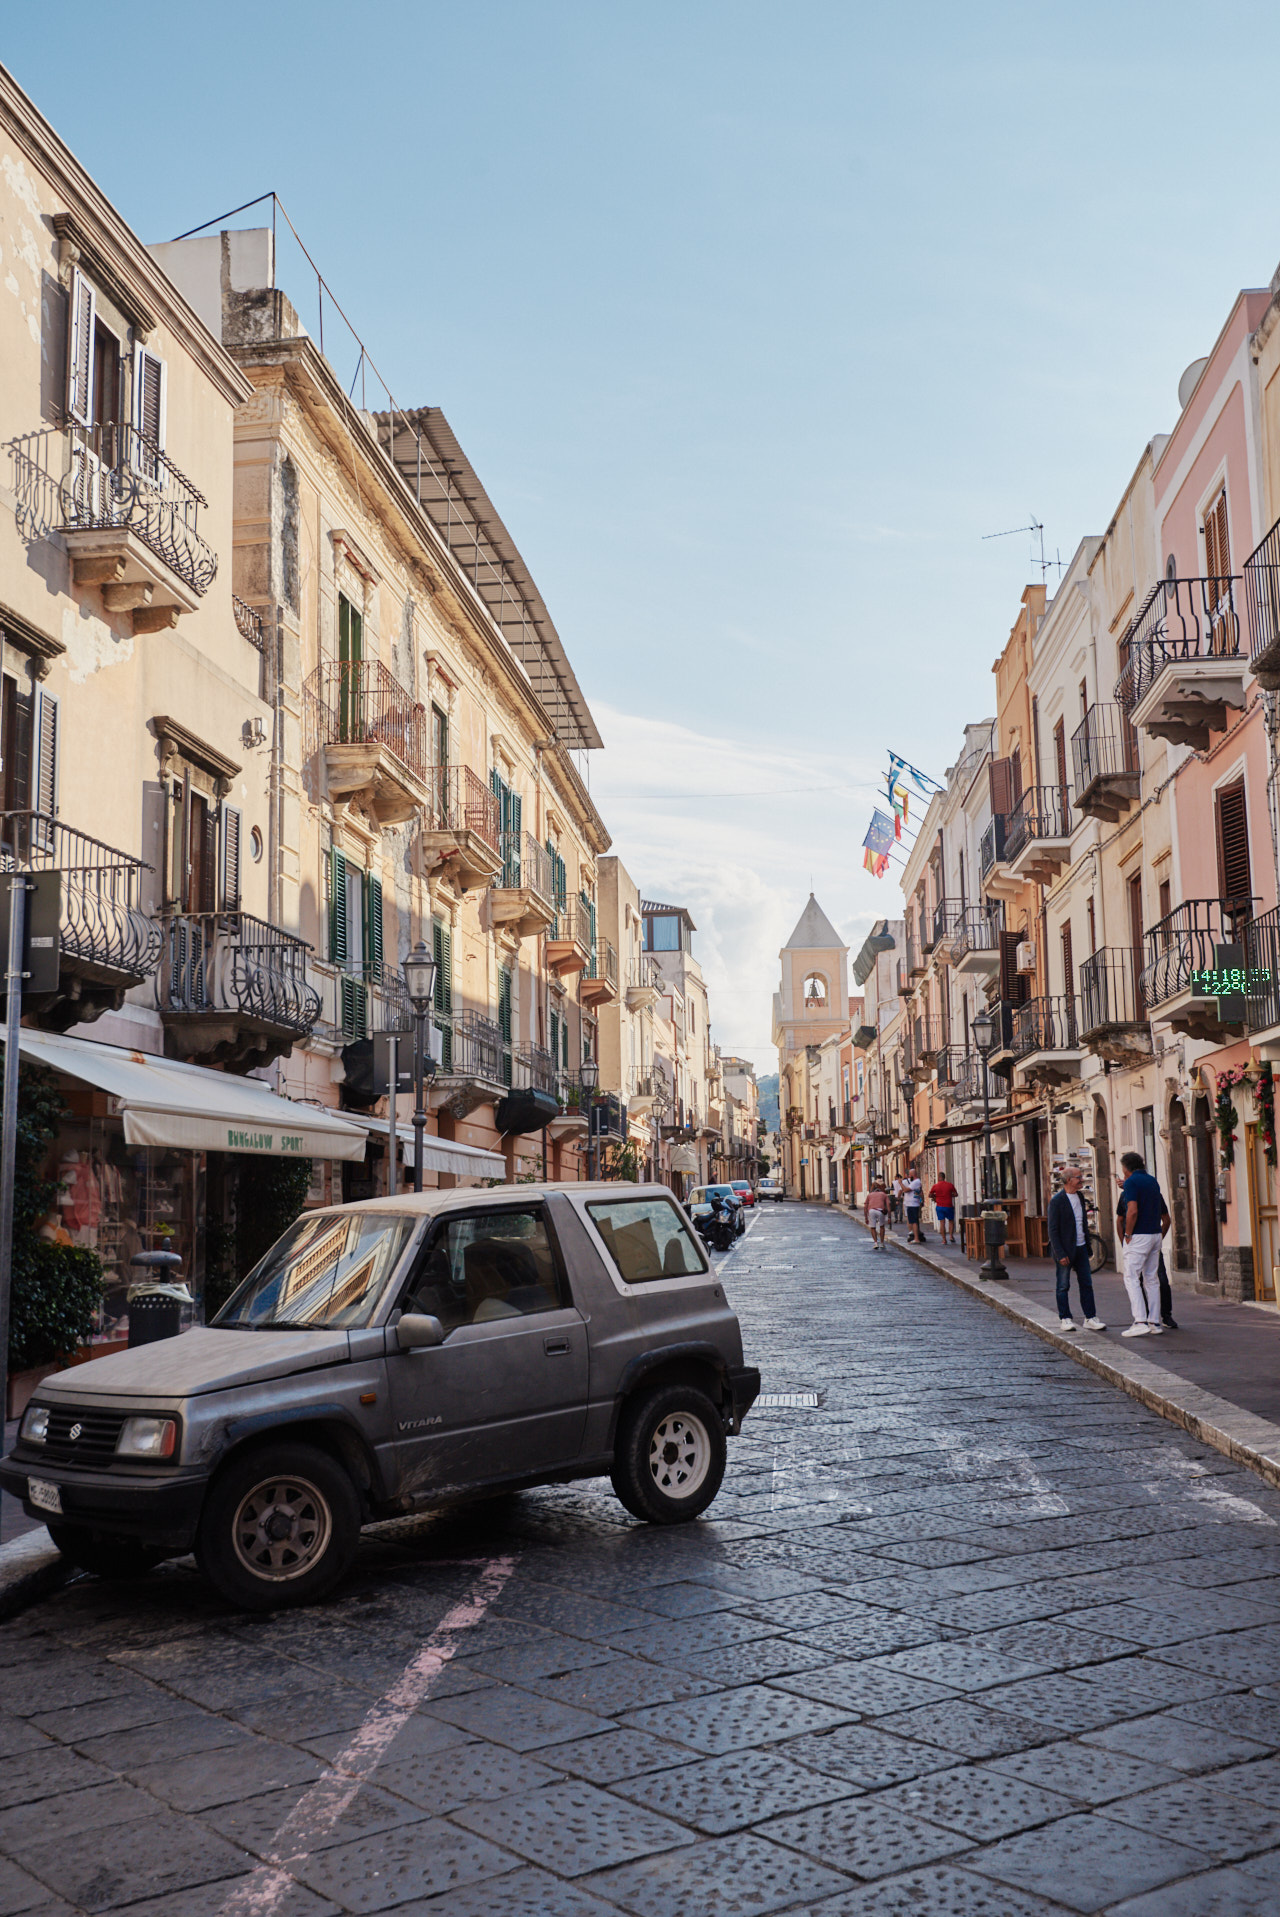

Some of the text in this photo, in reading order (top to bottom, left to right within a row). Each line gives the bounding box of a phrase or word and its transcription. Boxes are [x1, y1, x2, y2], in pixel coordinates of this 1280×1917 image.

[228, 1129, 304, 1152] BUNGALOW SPORT
[399, 1415, 443, 1431] VITARA
